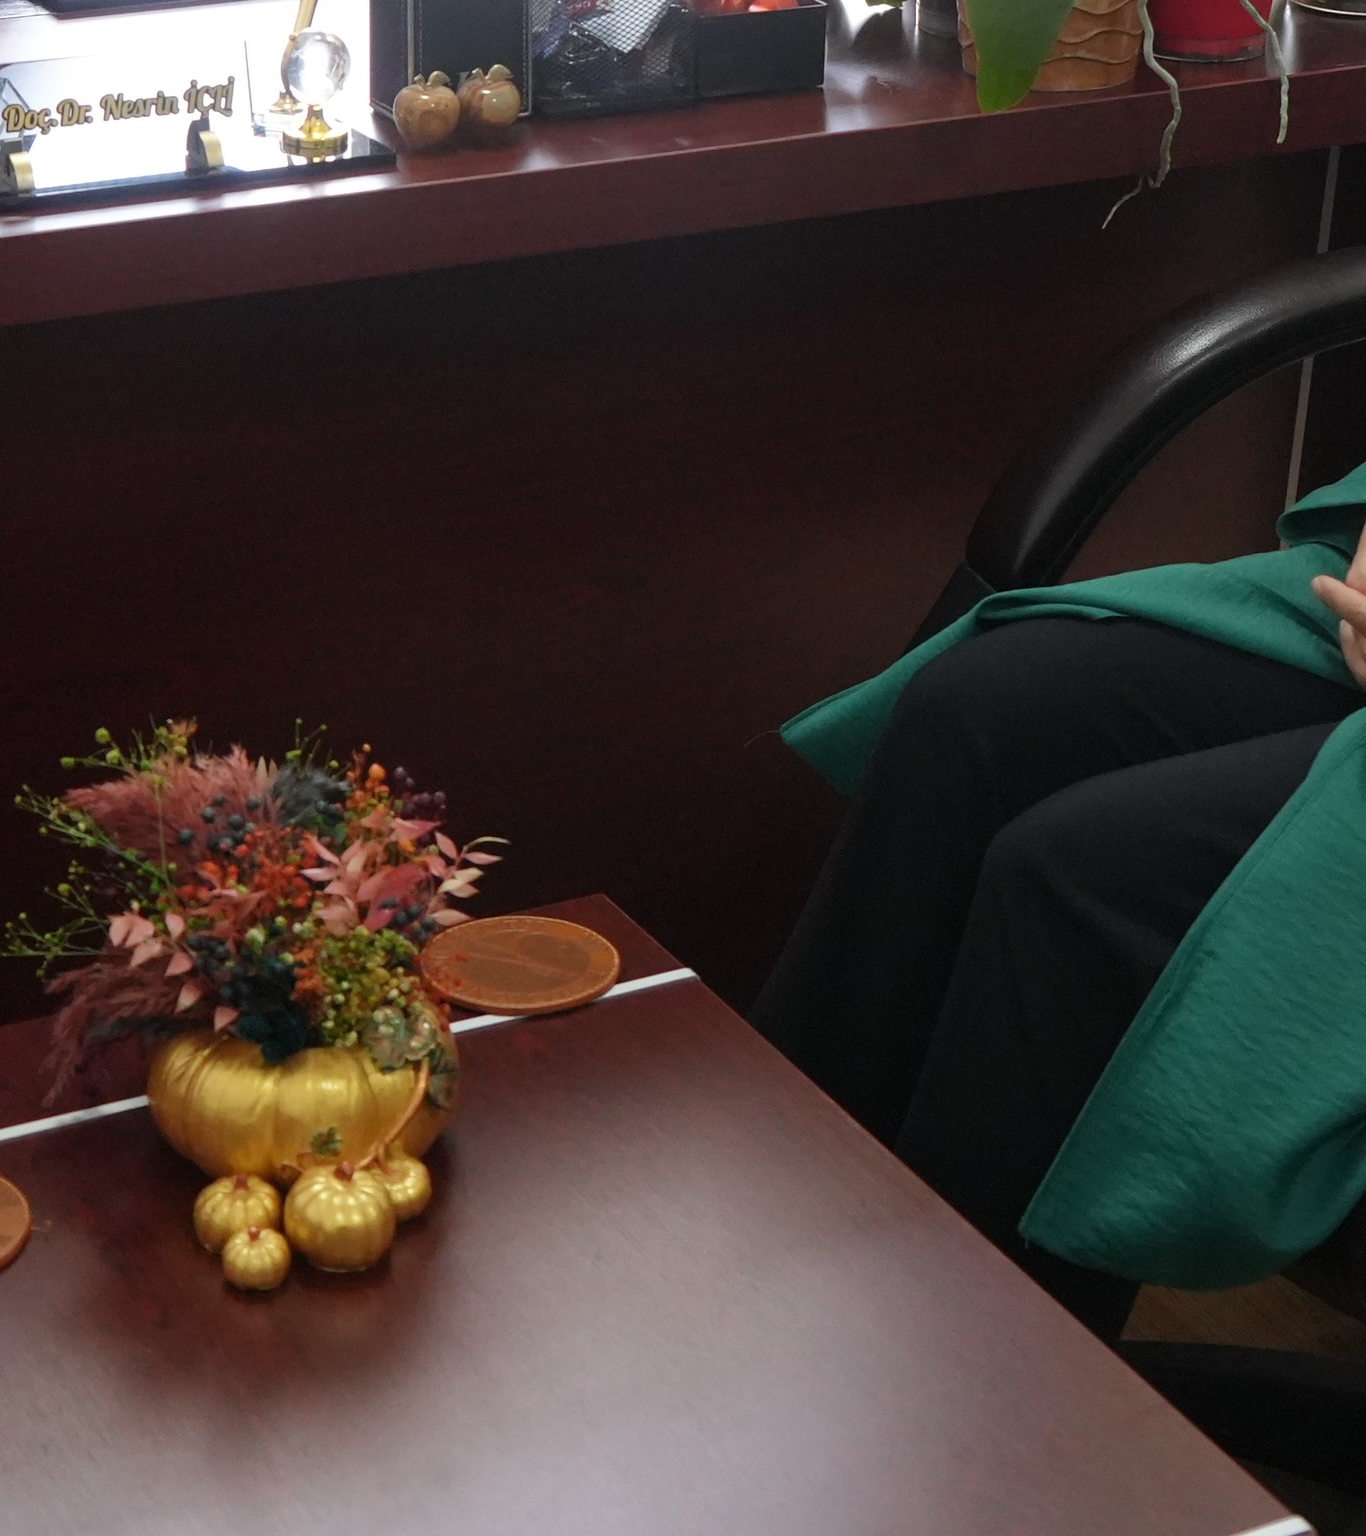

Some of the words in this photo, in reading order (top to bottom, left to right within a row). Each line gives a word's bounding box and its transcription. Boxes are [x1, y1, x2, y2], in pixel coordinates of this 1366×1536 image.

[2, 103, 58, 135] Doç.
[56, 98, 94, 127] Dr.
[100, 90, 180, 121] Nesrin
